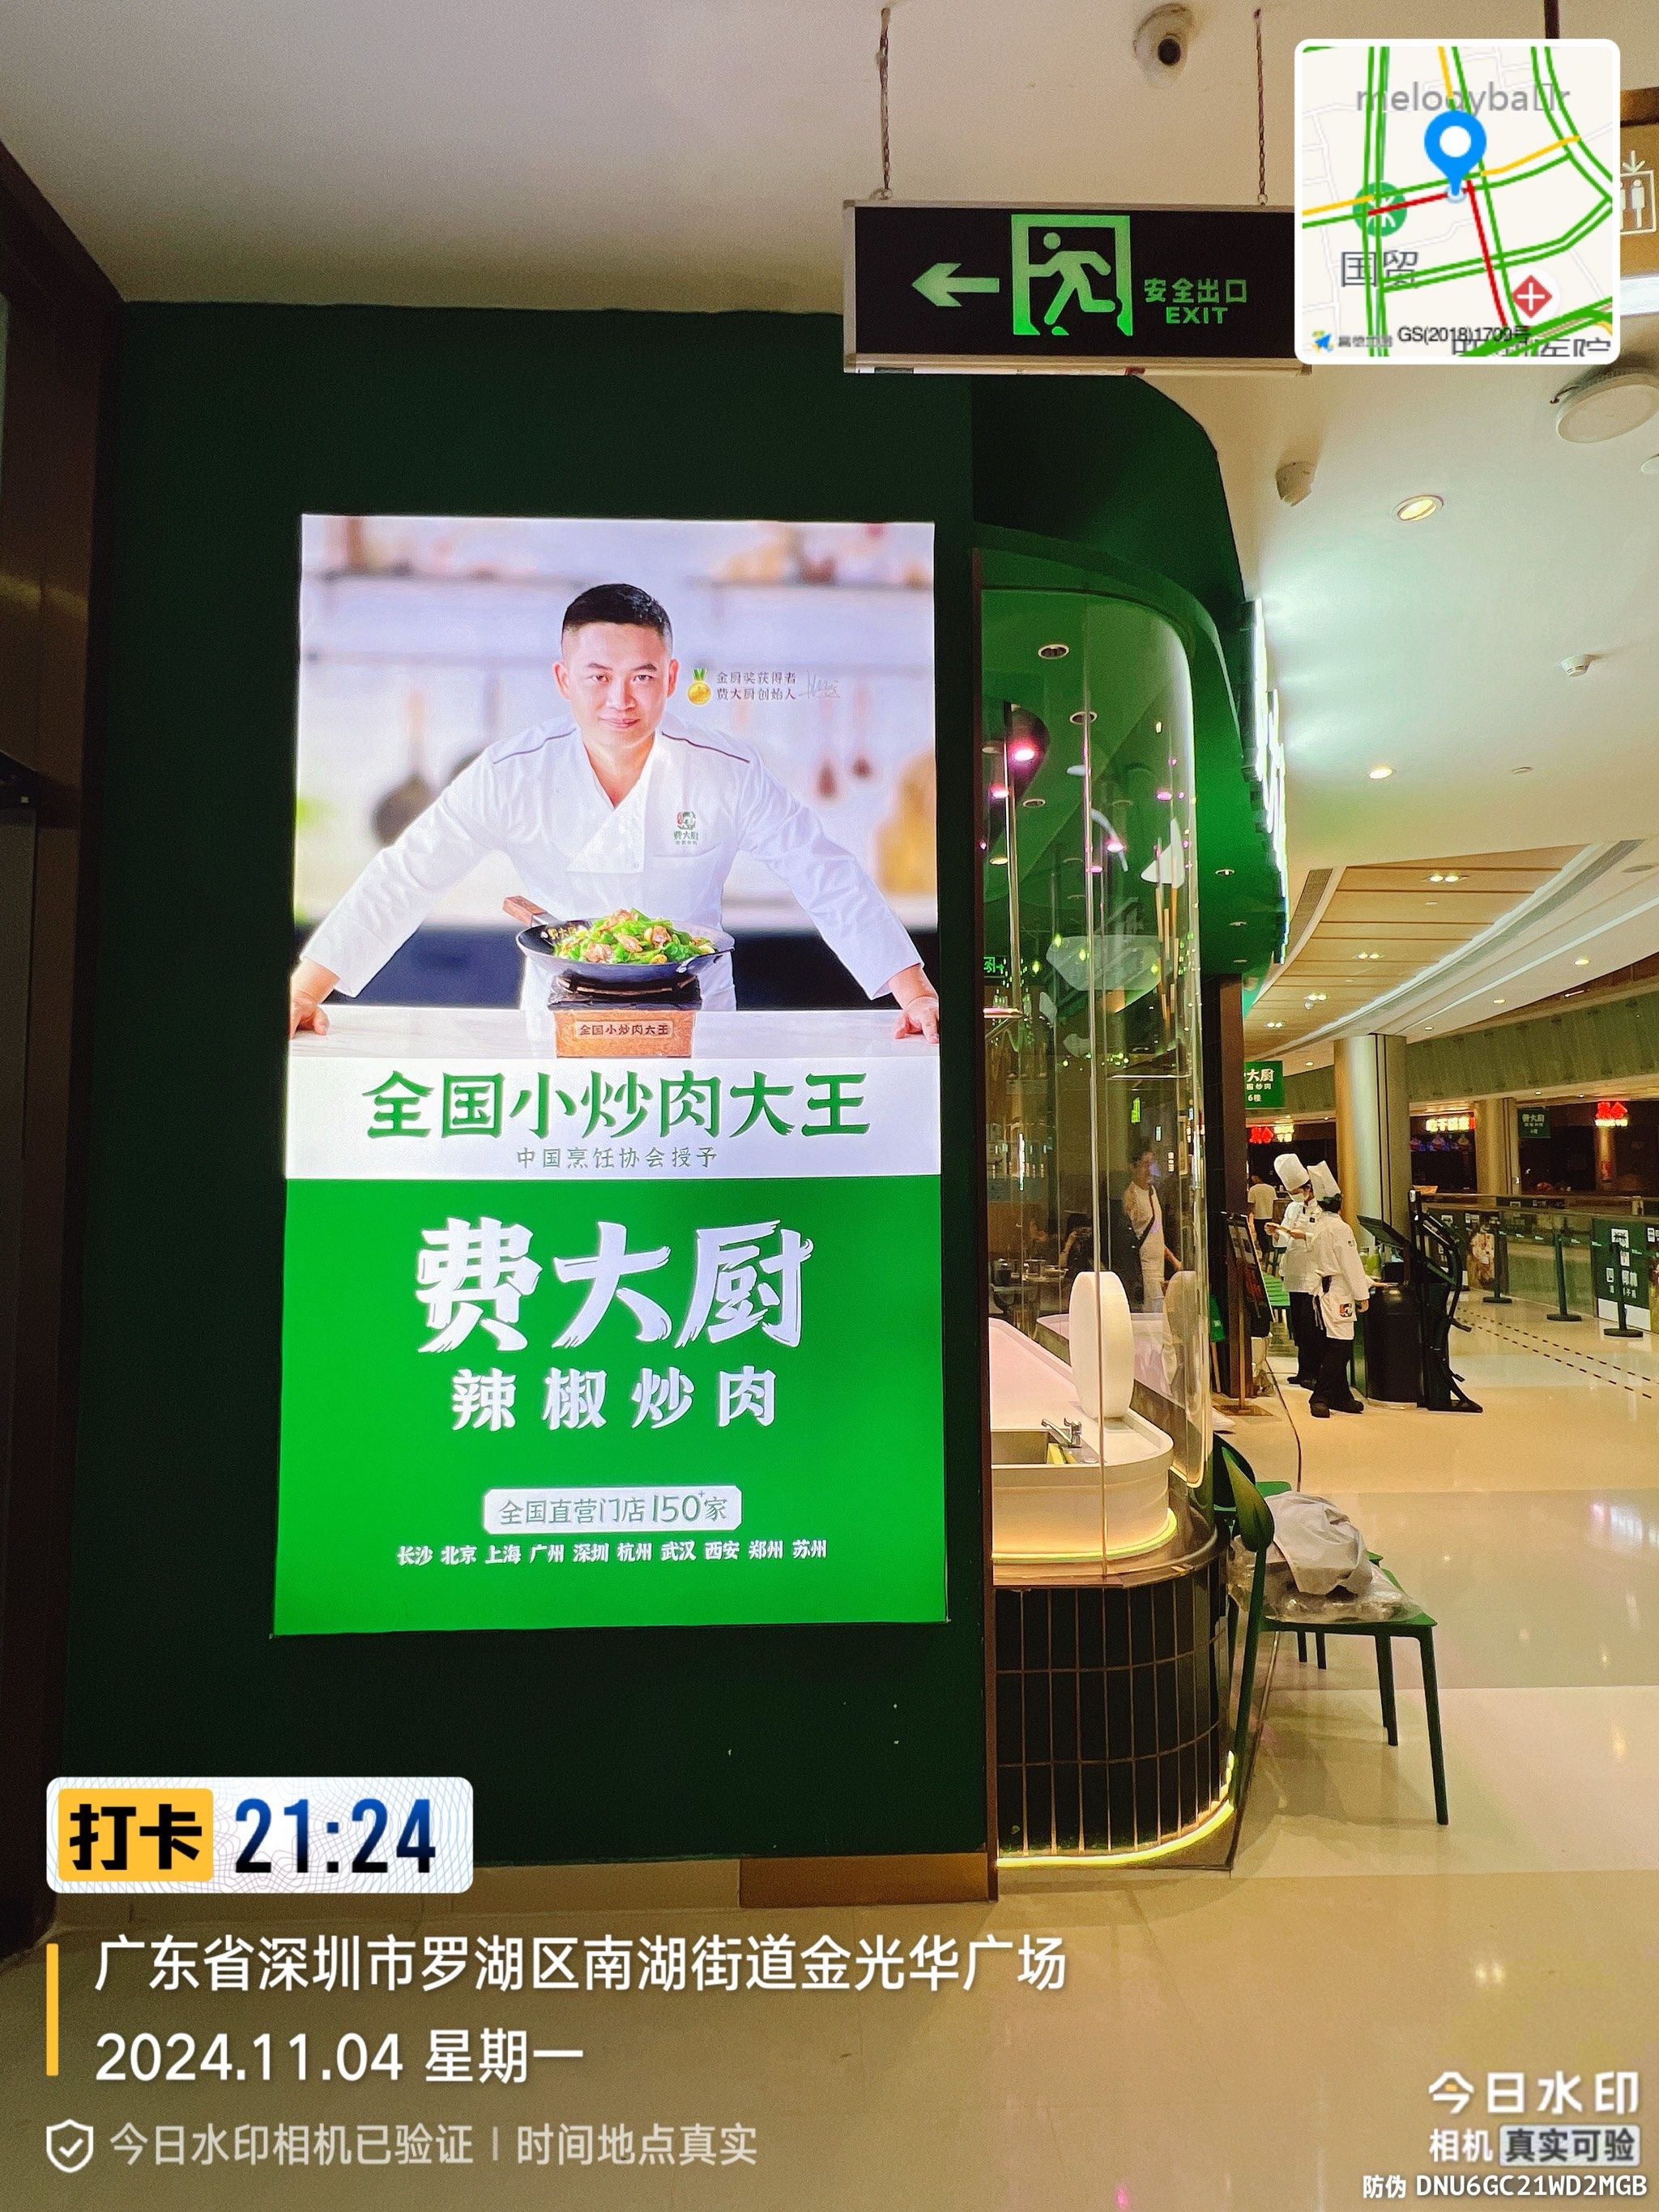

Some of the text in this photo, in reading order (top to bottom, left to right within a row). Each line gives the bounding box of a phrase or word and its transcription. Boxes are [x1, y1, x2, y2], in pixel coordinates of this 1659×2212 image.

[1144, 278, 1247, 303] 安全出口
[1166, 305, 1229, 325] EXIT
[716, 671, 797, 685] 金厨奖获得者
[716, 688, 797, 702] 费大厨创始人
[579, 1024, 669, 1036] 全国小炒肉大王
[1243, 1068, 1275, 1083] 大厨
[361, 1070, 872, 1140] 全国小炒肉大王
[516, 1147, 719, 1170] 中国烹饪协会授予
[415, 1216, 814, 1354] 费大厨
[451, 1364, 778, 1432] 辣椒炒肉
[397, 1539, 827, 1565] 长沙 北京 上海 广州 深圳 杭州 武汉 西安 郑州 苏州
